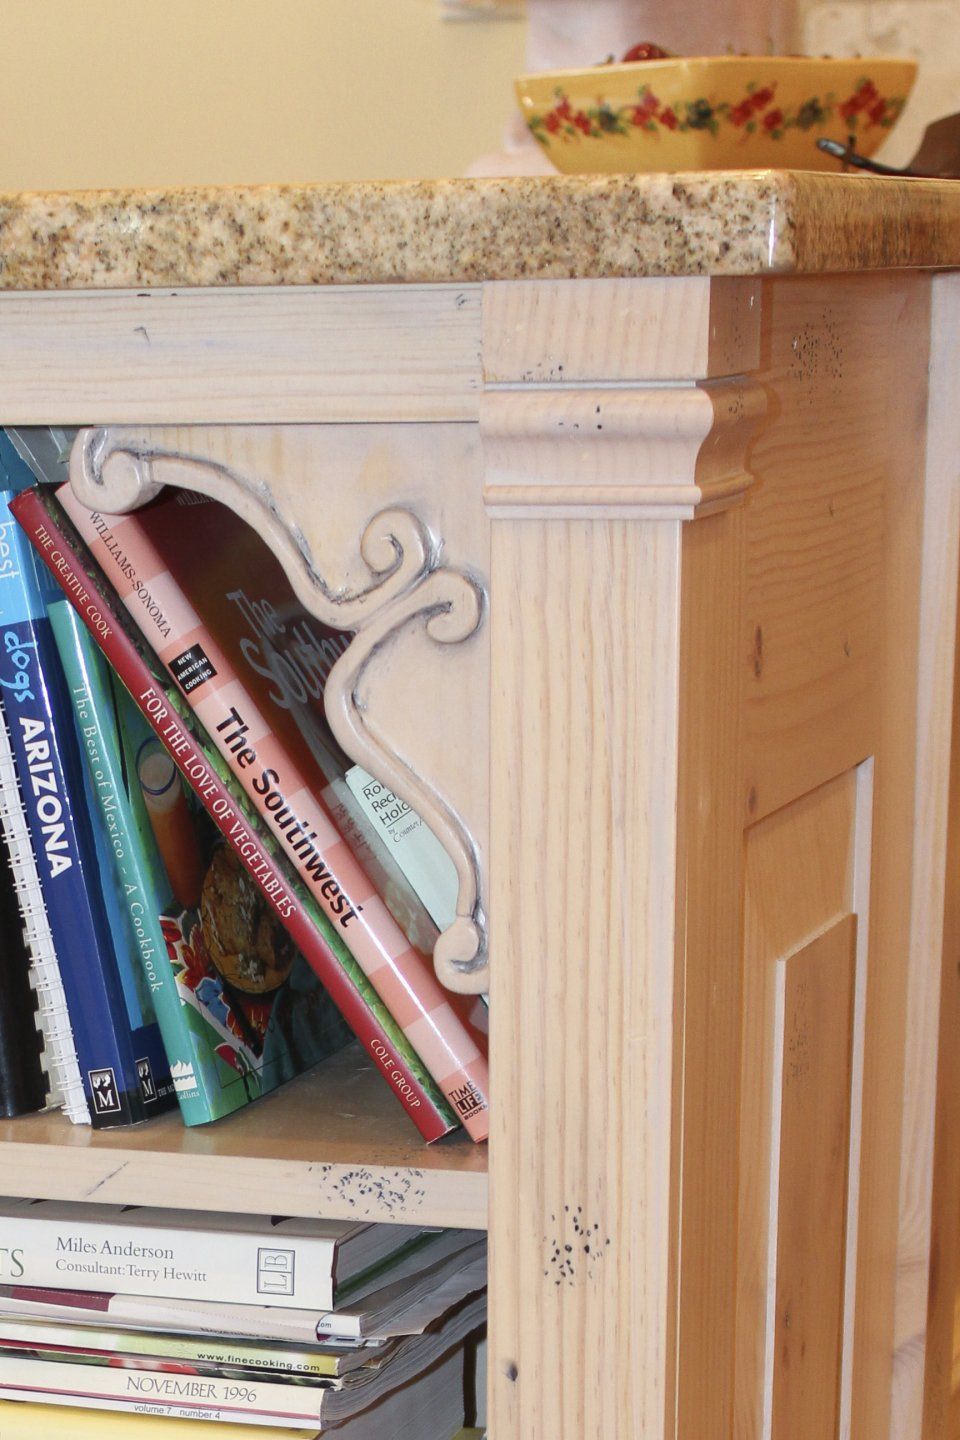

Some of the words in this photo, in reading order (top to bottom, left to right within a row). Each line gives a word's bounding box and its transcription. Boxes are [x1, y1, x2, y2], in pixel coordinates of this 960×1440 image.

[34, 524, 55, 551] THE
[50, 550, 90, 605] CREATIVE
[86, 604, 113, 640] COOK
[89, 511, 172, 639] WILLIAMS-SONOMA
[0, 631, 38, 703] dogs
[177, 652, 192, 666] NEW
[177, 657, 208, 681] AMERICAN
[184, 668, 212, 690] COOKING
[73, 686, 88, 719] The
[83, 723, 100, 764] Best
[95, 769, 111, 787] of
[19, 717, 73, 879] ARIZONA
[140, 687, 168, 724] FOR
[162, 721, 190, 758] THE
[183, 754, 219, 800] LOVE
[212, 798, 235, 826] OF
[228, 820, 298, 919] VEGETABLES
[101, 794, 125, 859] Mexico
[216, 706, 257, 769] The
[252, 768, 364, 928] Southwest
[124, 883, 138, 894] A
[128, 900, 164, 993] Cookbook
[370, 1039, 395, 1070] COLE
[391, 1070, 421, 1108] GROUP
[97, 1089, 115, 1108] M
[448, 1080, 476, 1102] TIME
[456, 1091, 483, 1115] LIFE
[56, 1236, 97, 1254] Miles
[100, 1239, 174, 1260] Anderson
[127, 1264, 160, 1281] Terry
[163, 1266, 207, 1283] Hewitt
[197, 1352, 320, 1372] www.finecooking.com
[126, 1375, 217, 1401] NOVEMBER
[222, 1386, 257, 1403] 1996
[134, 1404, 163, 1415] volume
[165, 1405, 172, 1415] 7
[179, 1408, 212, 1419] number
[214, 1411, 221, 1419] 4
